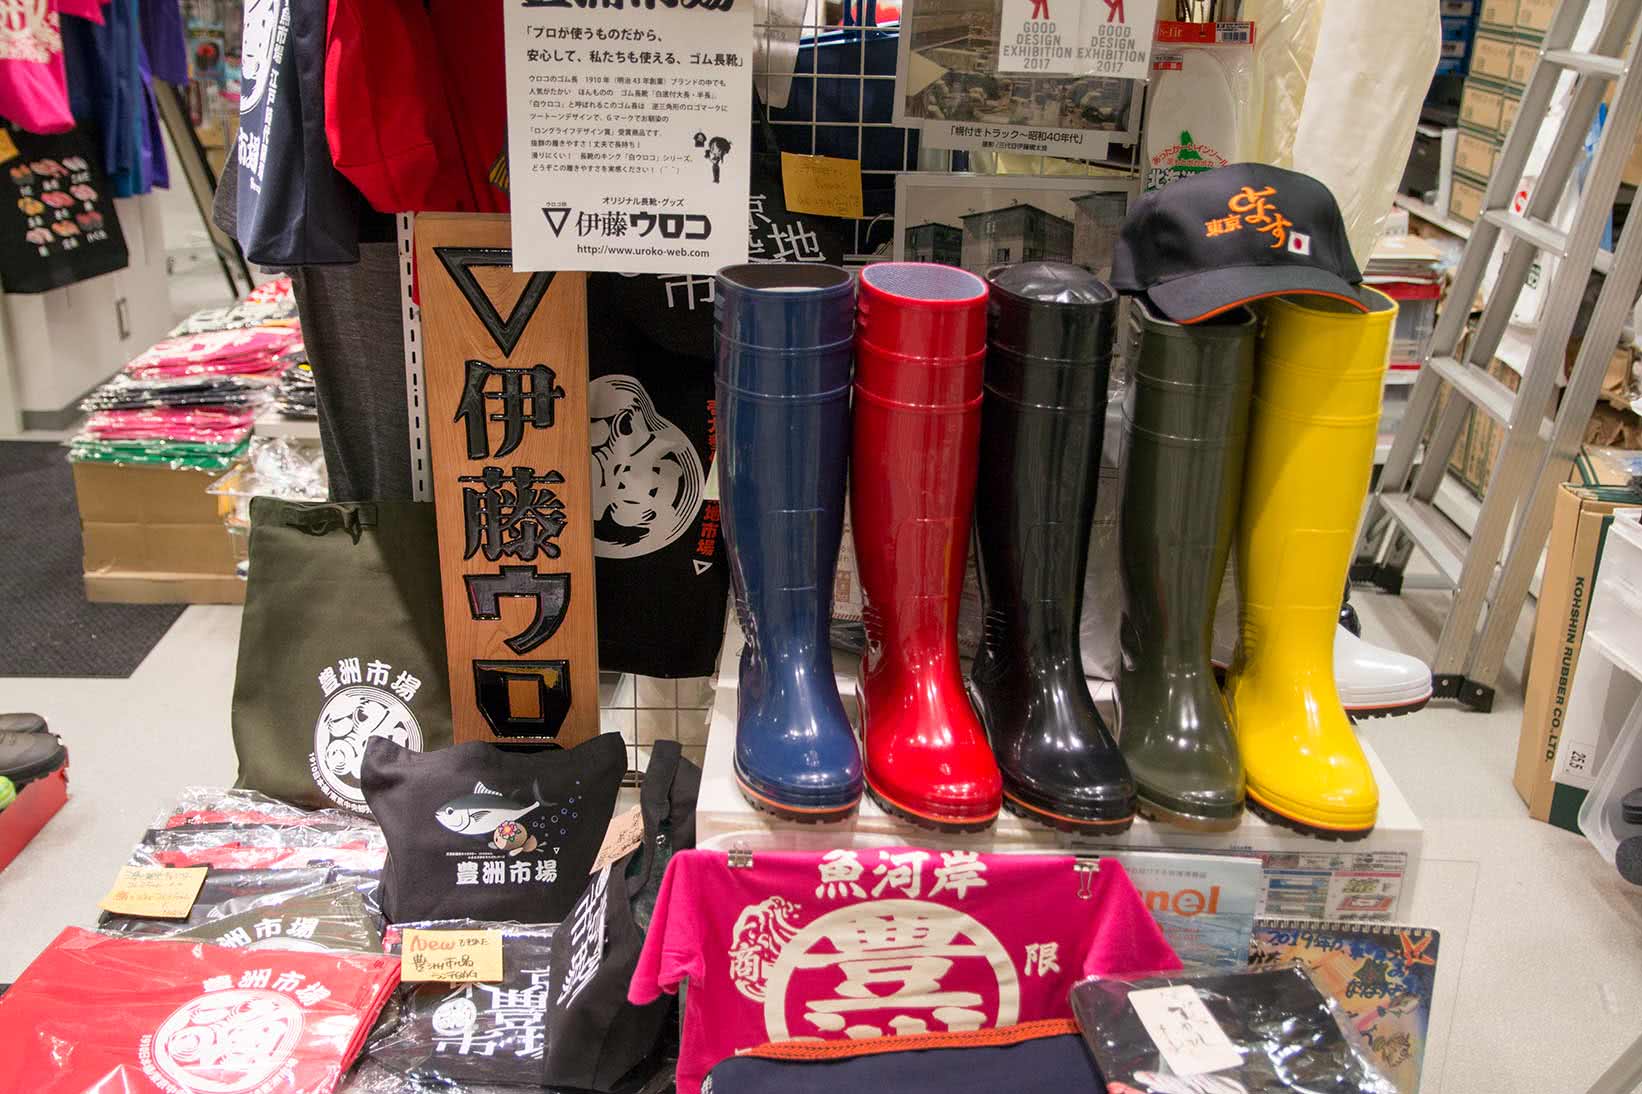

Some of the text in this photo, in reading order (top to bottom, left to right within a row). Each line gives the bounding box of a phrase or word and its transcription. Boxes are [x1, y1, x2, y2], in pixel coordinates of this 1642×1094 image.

[525, 25, 663, 42] 「プロが使うものだから、
[1022, 22, 1057, 34] GOOD
[1097, 26, 1132, 38] GOOD
[1016, 34, 1061, 46] DESIGN
[1090, 37, 1135, 50] DESIGN
[526, 49, 745, 67] 安心して、私たちも使える、ゴム長靴」
[1003, 45, 1072, 59] EXHIBITION
[1076, 48, 1146, 63] EXHIBITION
[1023, 58, 1051, 70] 2017
[1096, 61, 1124, 73] 2017
[575, 211, 712, 240] 伊藤ウロコ
[1205, 214, 1243, 237] 東京
[577, 244, 710, 258] http://www.uroko-web.com
[453, 359, 574, 752] 伊藤ウロ
[1567, 576, 1585, 644] KOHSHIN
[317, 657, 422, 702] 豊洲市場
[1556, 646, 1574, 705] RUBBER
[456, 859, 557, 884] 豊洲市場
[815, 849, 987, 899] 魚河岸
[410, 935, 456, 953] New
